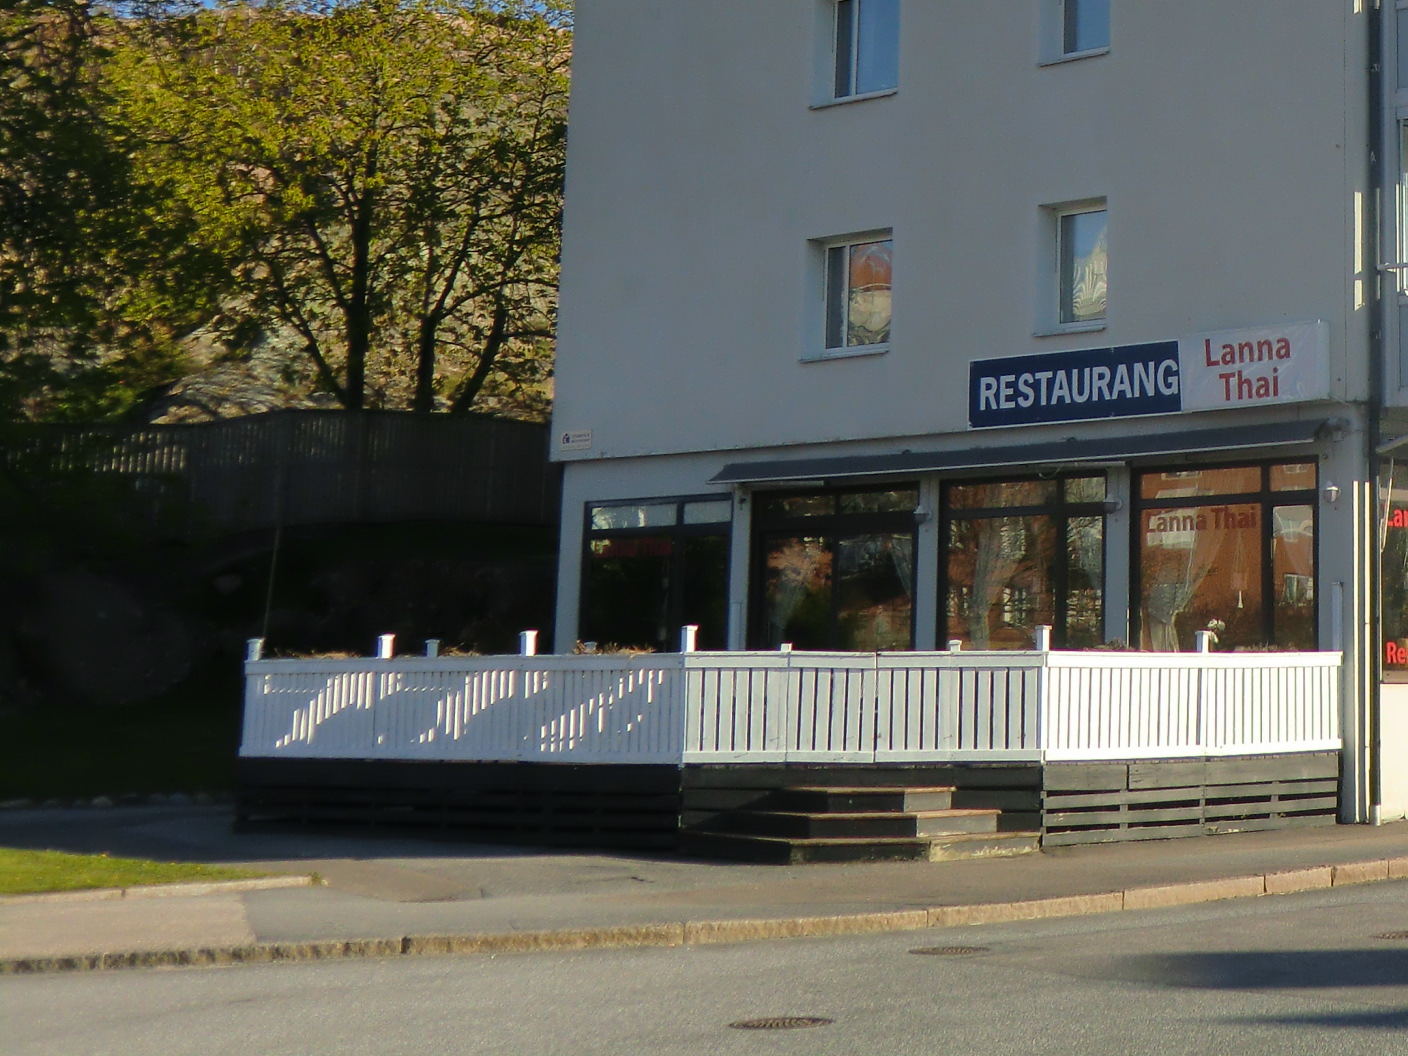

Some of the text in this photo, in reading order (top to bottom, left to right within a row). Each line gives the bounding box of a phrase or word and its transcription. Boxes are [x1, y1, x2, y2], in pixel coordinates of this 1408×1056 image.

[1204, 337, 1292, 367] Lanna
[979, 359, 1179, 411] RESTAURANG
[1219, 367, 1280, 401] Thai
[1145, 505, 1257, 533] Lanna Thai
